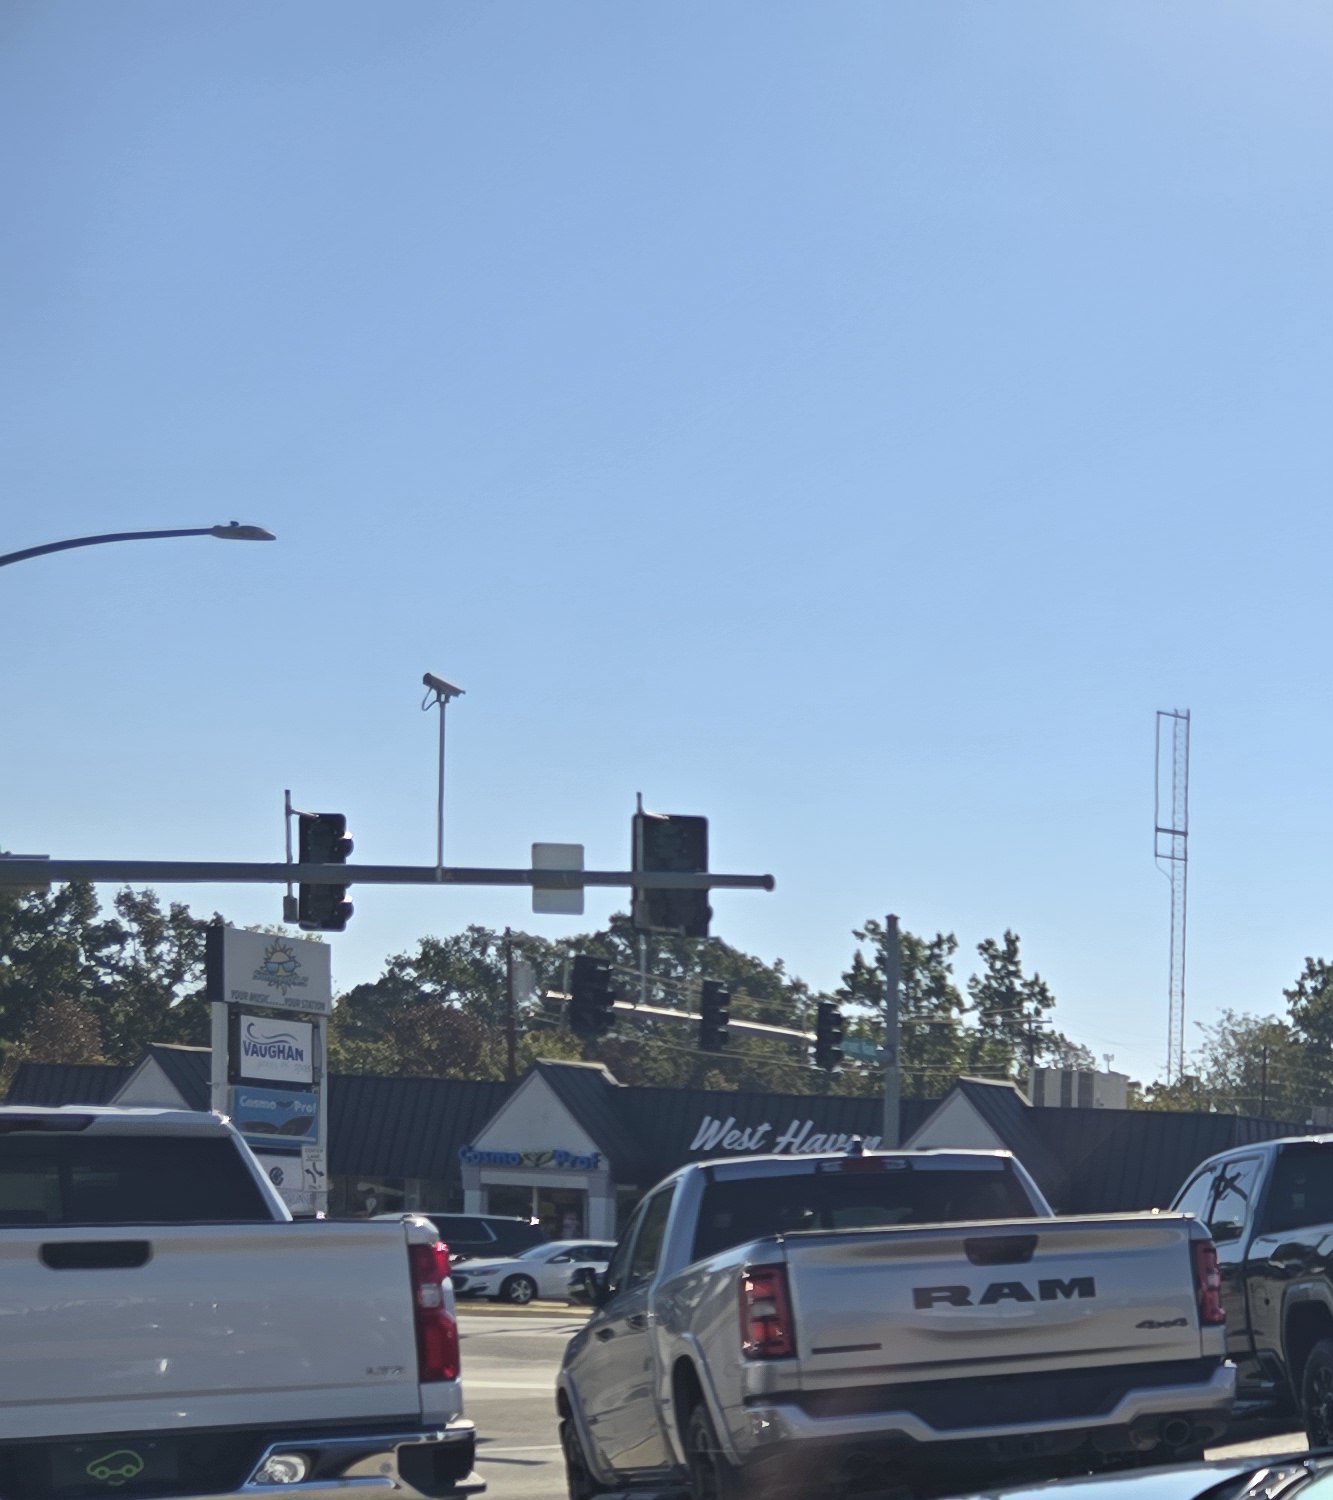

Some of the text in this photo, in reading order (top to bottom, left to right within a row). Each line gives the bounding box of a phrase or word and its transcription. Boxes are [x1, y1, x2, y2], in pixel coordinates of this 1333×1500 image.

[242, 1040, 304, 1062] VAUGHAN
[240, 1095, 317, 1113] Cosmo Prof
[690, 1115, 883, 1154] West Havn
[458, 1144, 601, 1169] Cosmo Prof
[911, 1276, 1096, 1310] RAM
